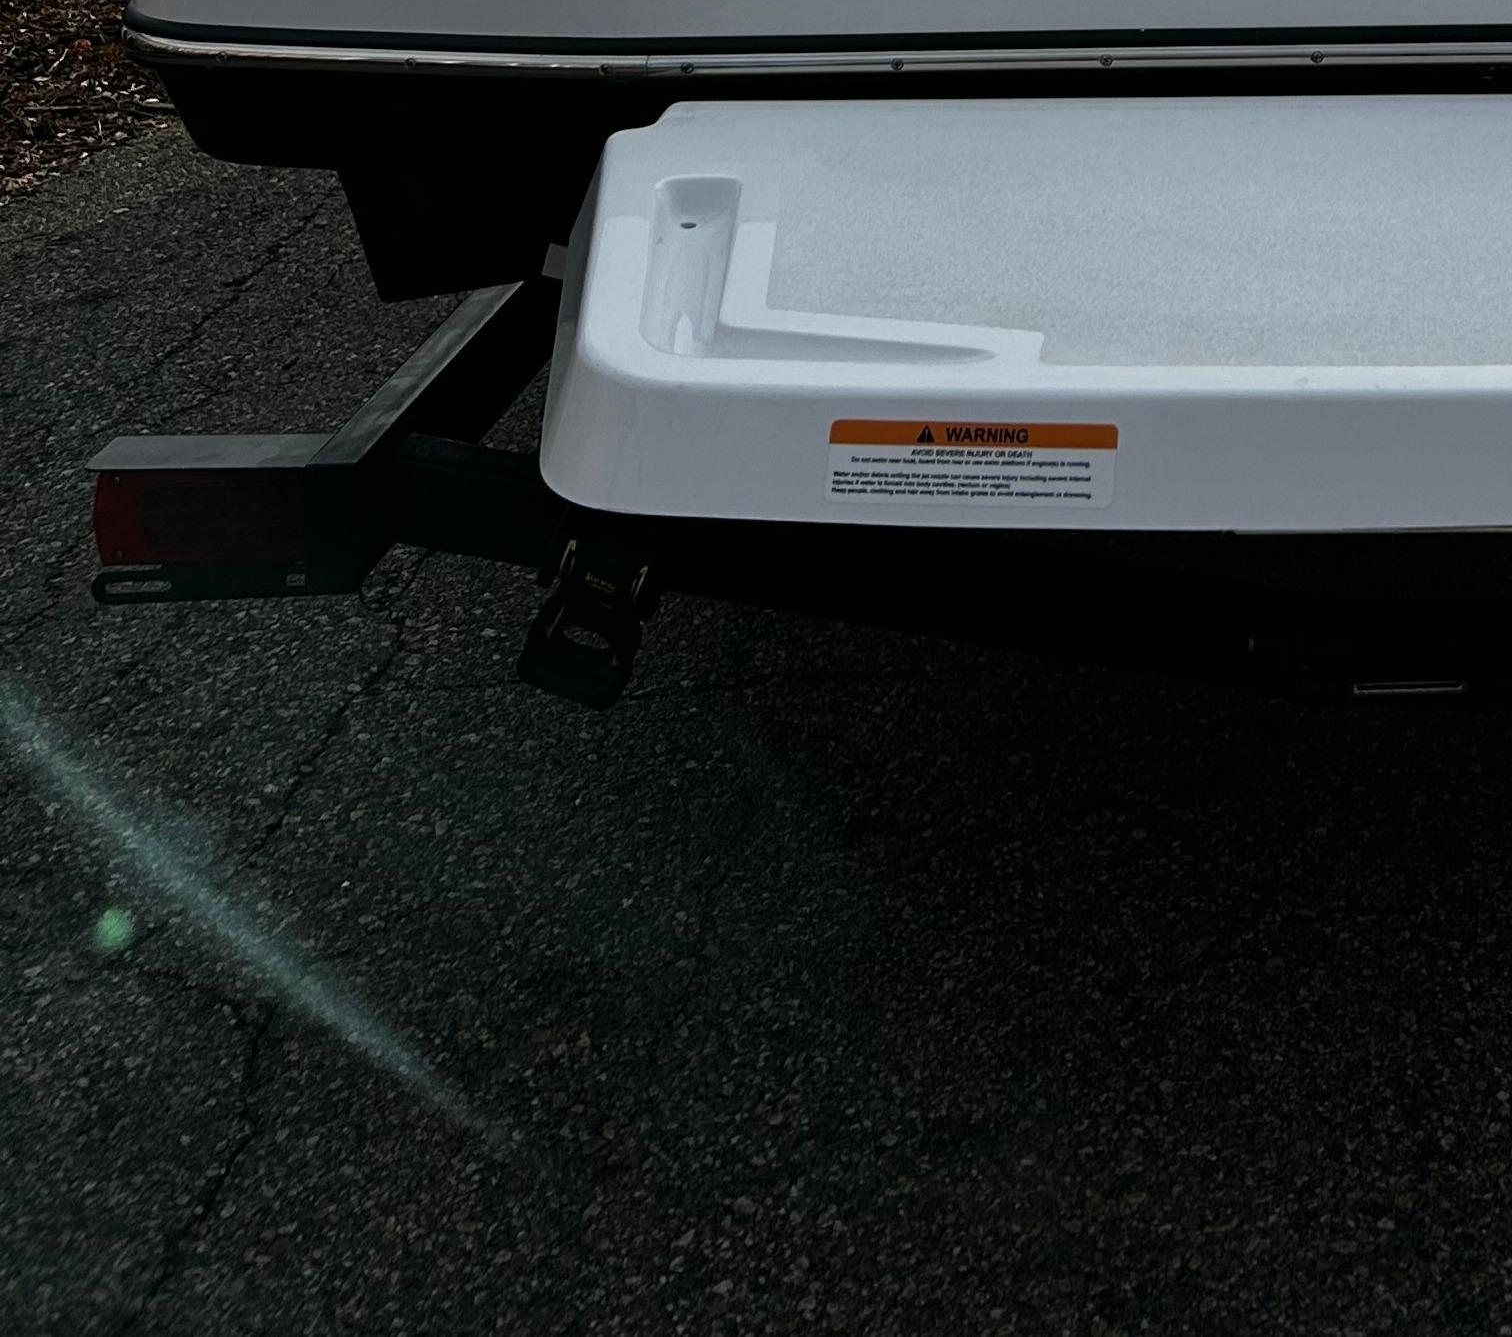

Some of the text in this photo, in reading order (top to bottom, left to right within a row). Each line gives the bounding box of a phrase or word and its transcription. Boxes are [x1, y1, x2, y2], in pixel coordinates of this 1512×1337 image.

[945, 427, 1029, 444] WARNING
[935, 449, 964, 457] SEVERE
[1007, 450, 1033, 458] DEATH
